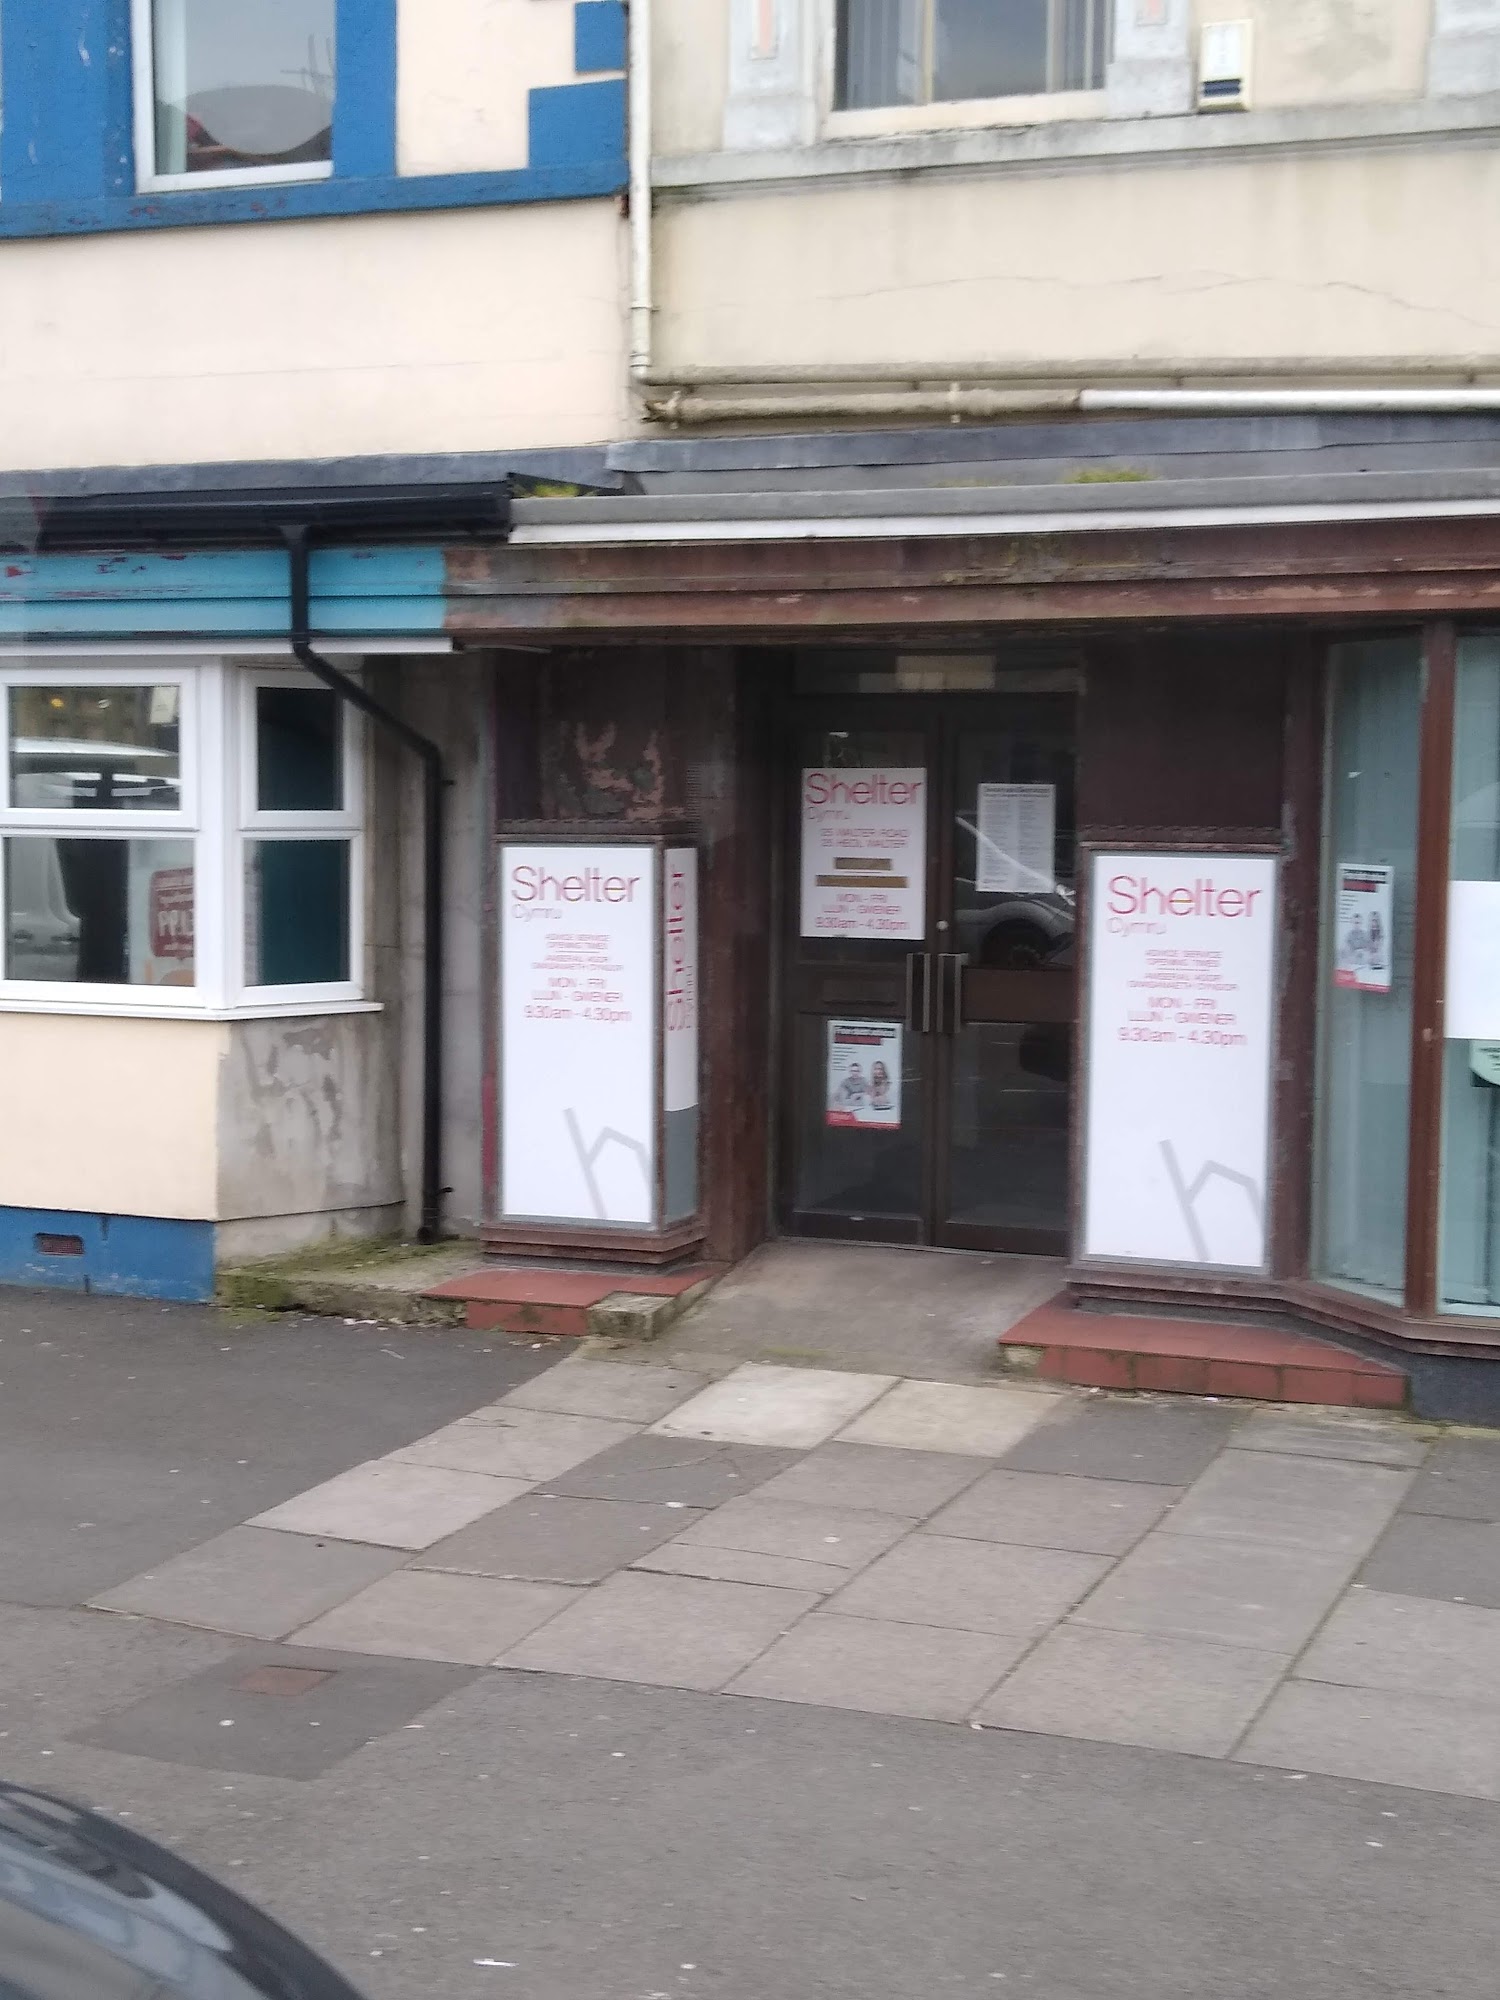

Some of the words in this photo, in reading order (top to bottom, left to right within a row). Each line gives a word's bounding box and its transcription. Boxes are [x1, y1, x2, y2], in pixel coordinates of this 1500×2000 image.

[804, 773, 922, 804] Shelter
[511, 865, 640, 903] Shelter
[1107, 875, 1263, 918] Shelter
